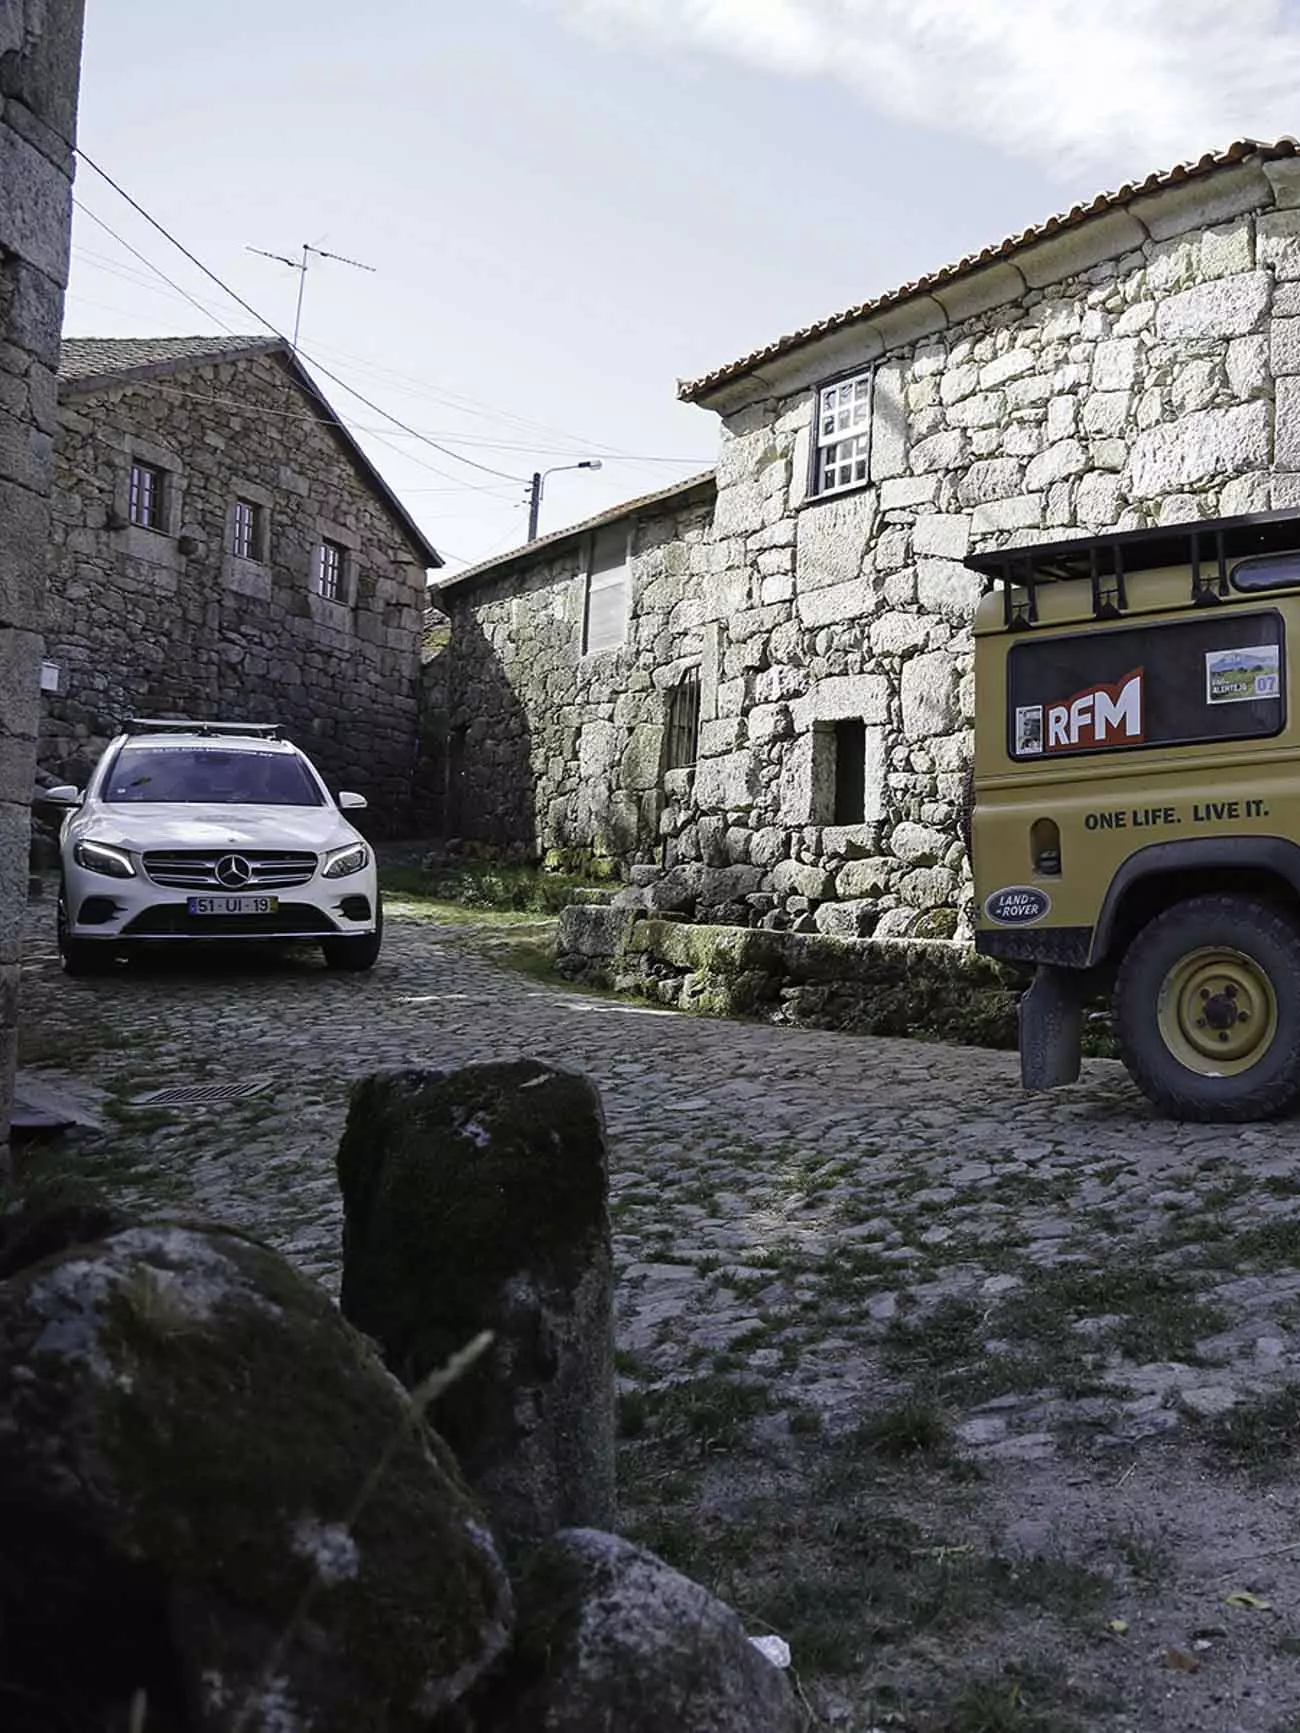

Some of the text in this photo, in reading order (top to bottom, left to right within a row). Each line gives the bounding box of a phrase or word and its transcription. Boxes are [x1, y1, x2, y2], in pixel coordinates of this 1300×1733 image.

[1257, 675, 1276, 692] 07
[1048, 675, 1141, 746] RFM
[1085, 799, 1270, 830] ONE LIFE. LIVE IT.
